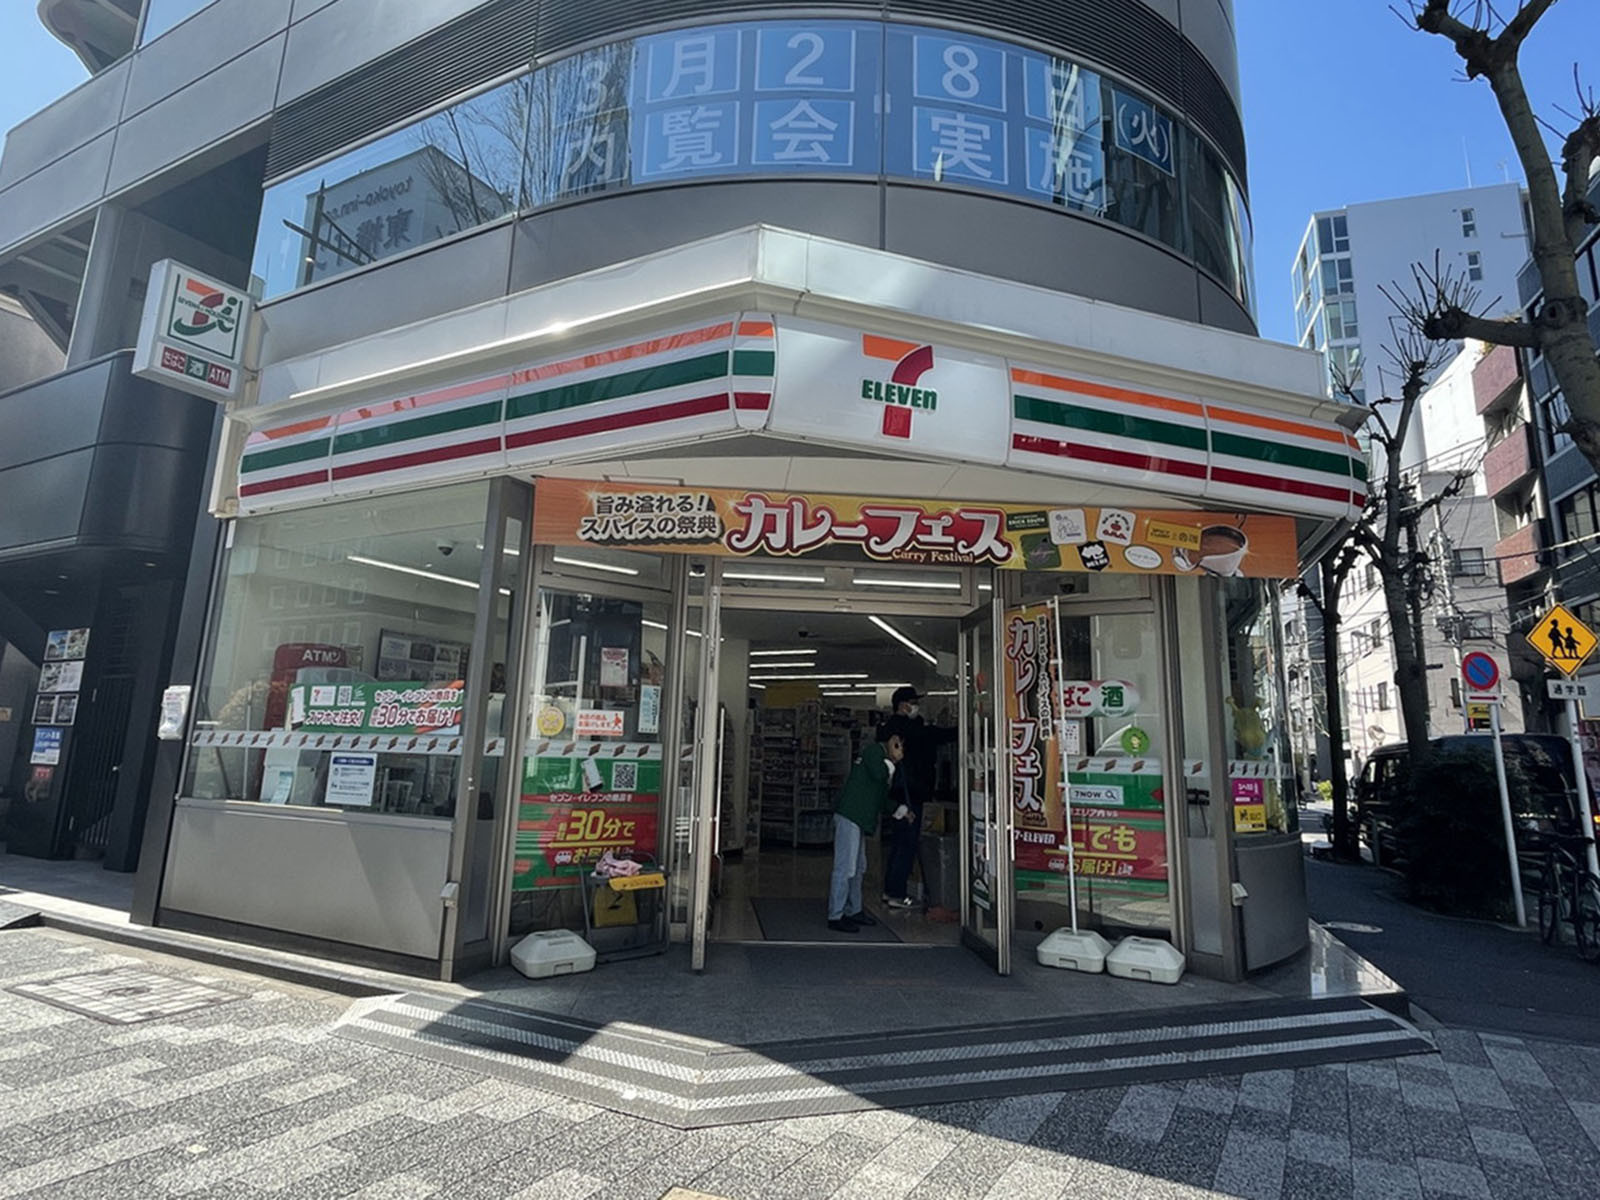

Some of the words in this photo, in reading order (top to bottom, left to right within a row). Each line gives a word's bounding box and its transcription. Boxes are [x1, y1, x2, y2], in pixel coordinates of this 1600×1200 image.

[208, 367, 231, 387] ATM
[861, 379, 938, 411] ELEVEN
[580, 514, 718, 536] スパイスの祭典
[727, 496, 1010, 559] カレーフェス
[931, 550, 975, 563] Festival
[1062, 686, 1092, 708] ばこ
[1101, 685, 1125, 708] 酒
[1007, 617, 1044, 812] カレーフェス
[1075, 790, 1102, 799] 7NOW
[1064, 824, 1137, 852] こでも
